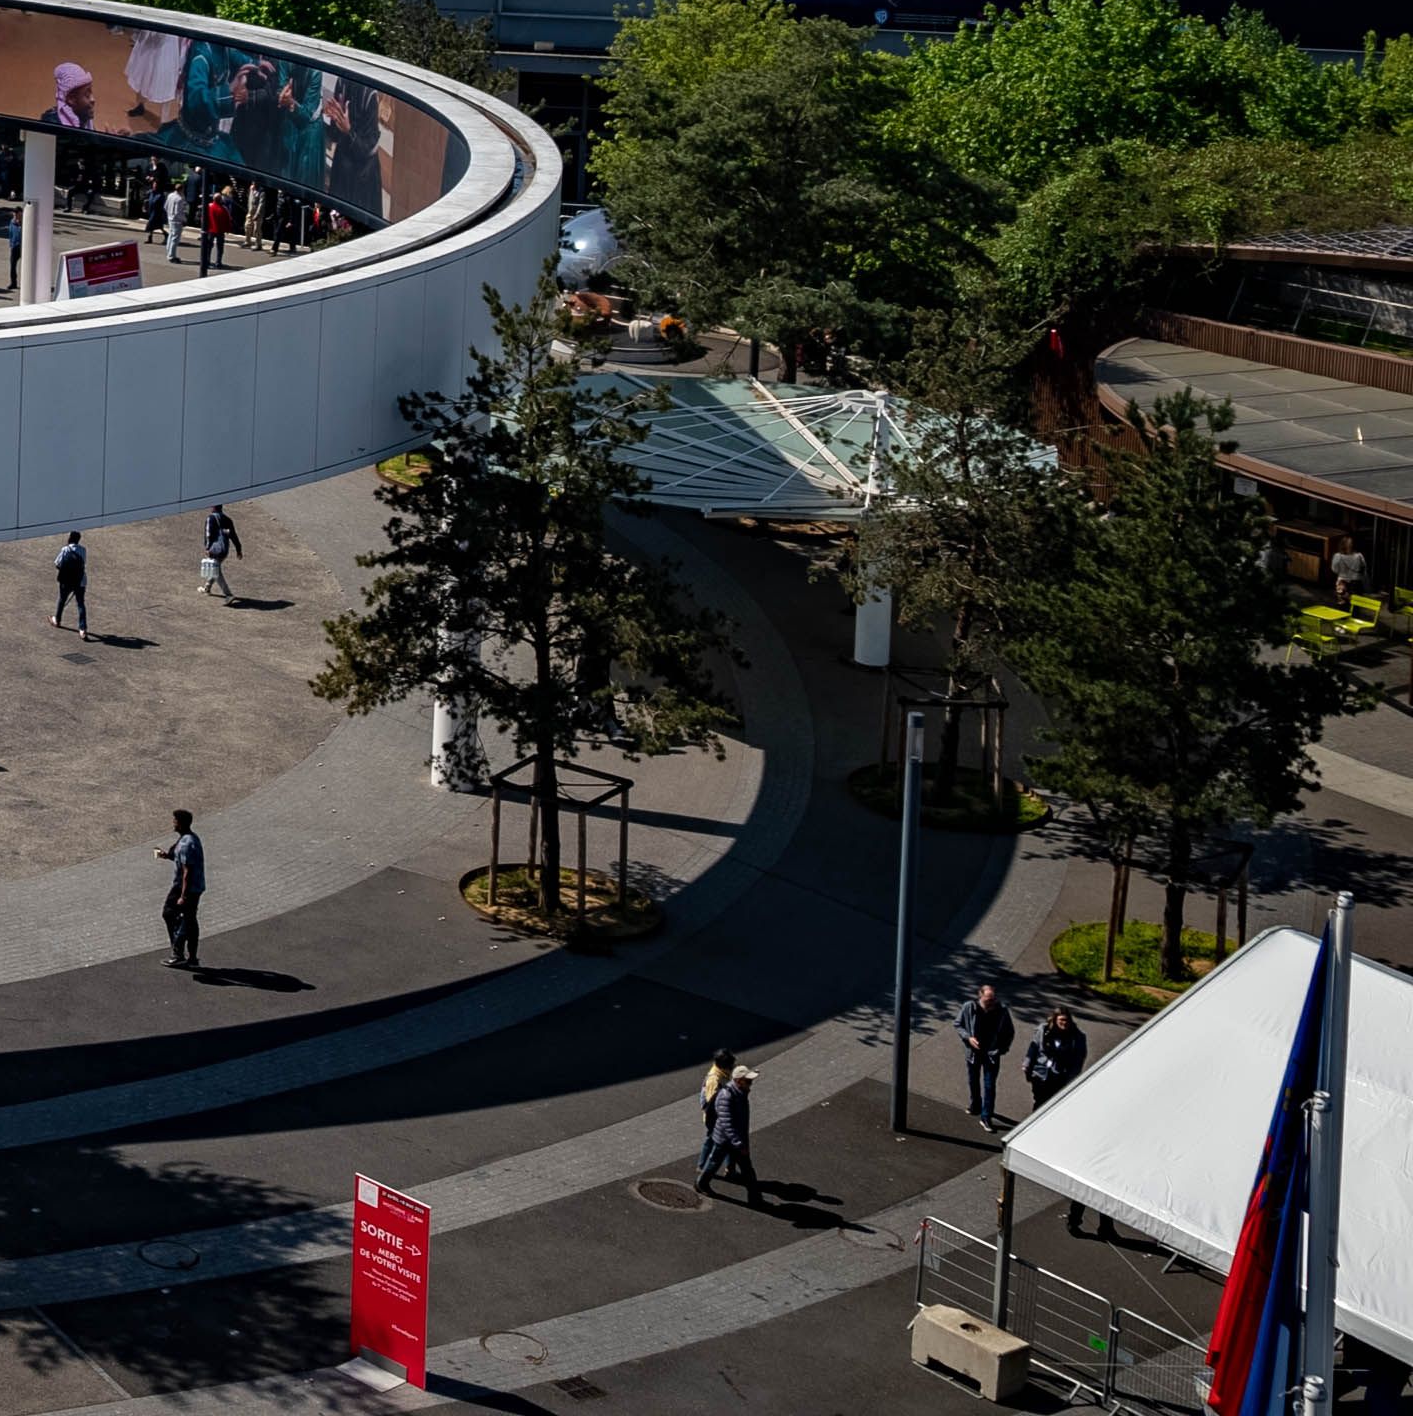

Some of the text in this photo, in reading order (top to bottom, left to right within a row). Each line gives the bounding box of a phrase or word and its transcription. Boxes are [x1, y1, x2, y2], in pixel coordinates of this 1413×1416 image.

[360, 1220, 404, 1251] SORTIE
[360, 1248, 371, 1259] DE
[371, 1253, 397, 1272] VOTRE
[397, 1265, 422, 1284] VISITE
[378, 1247, 403, 1265] MERCI
